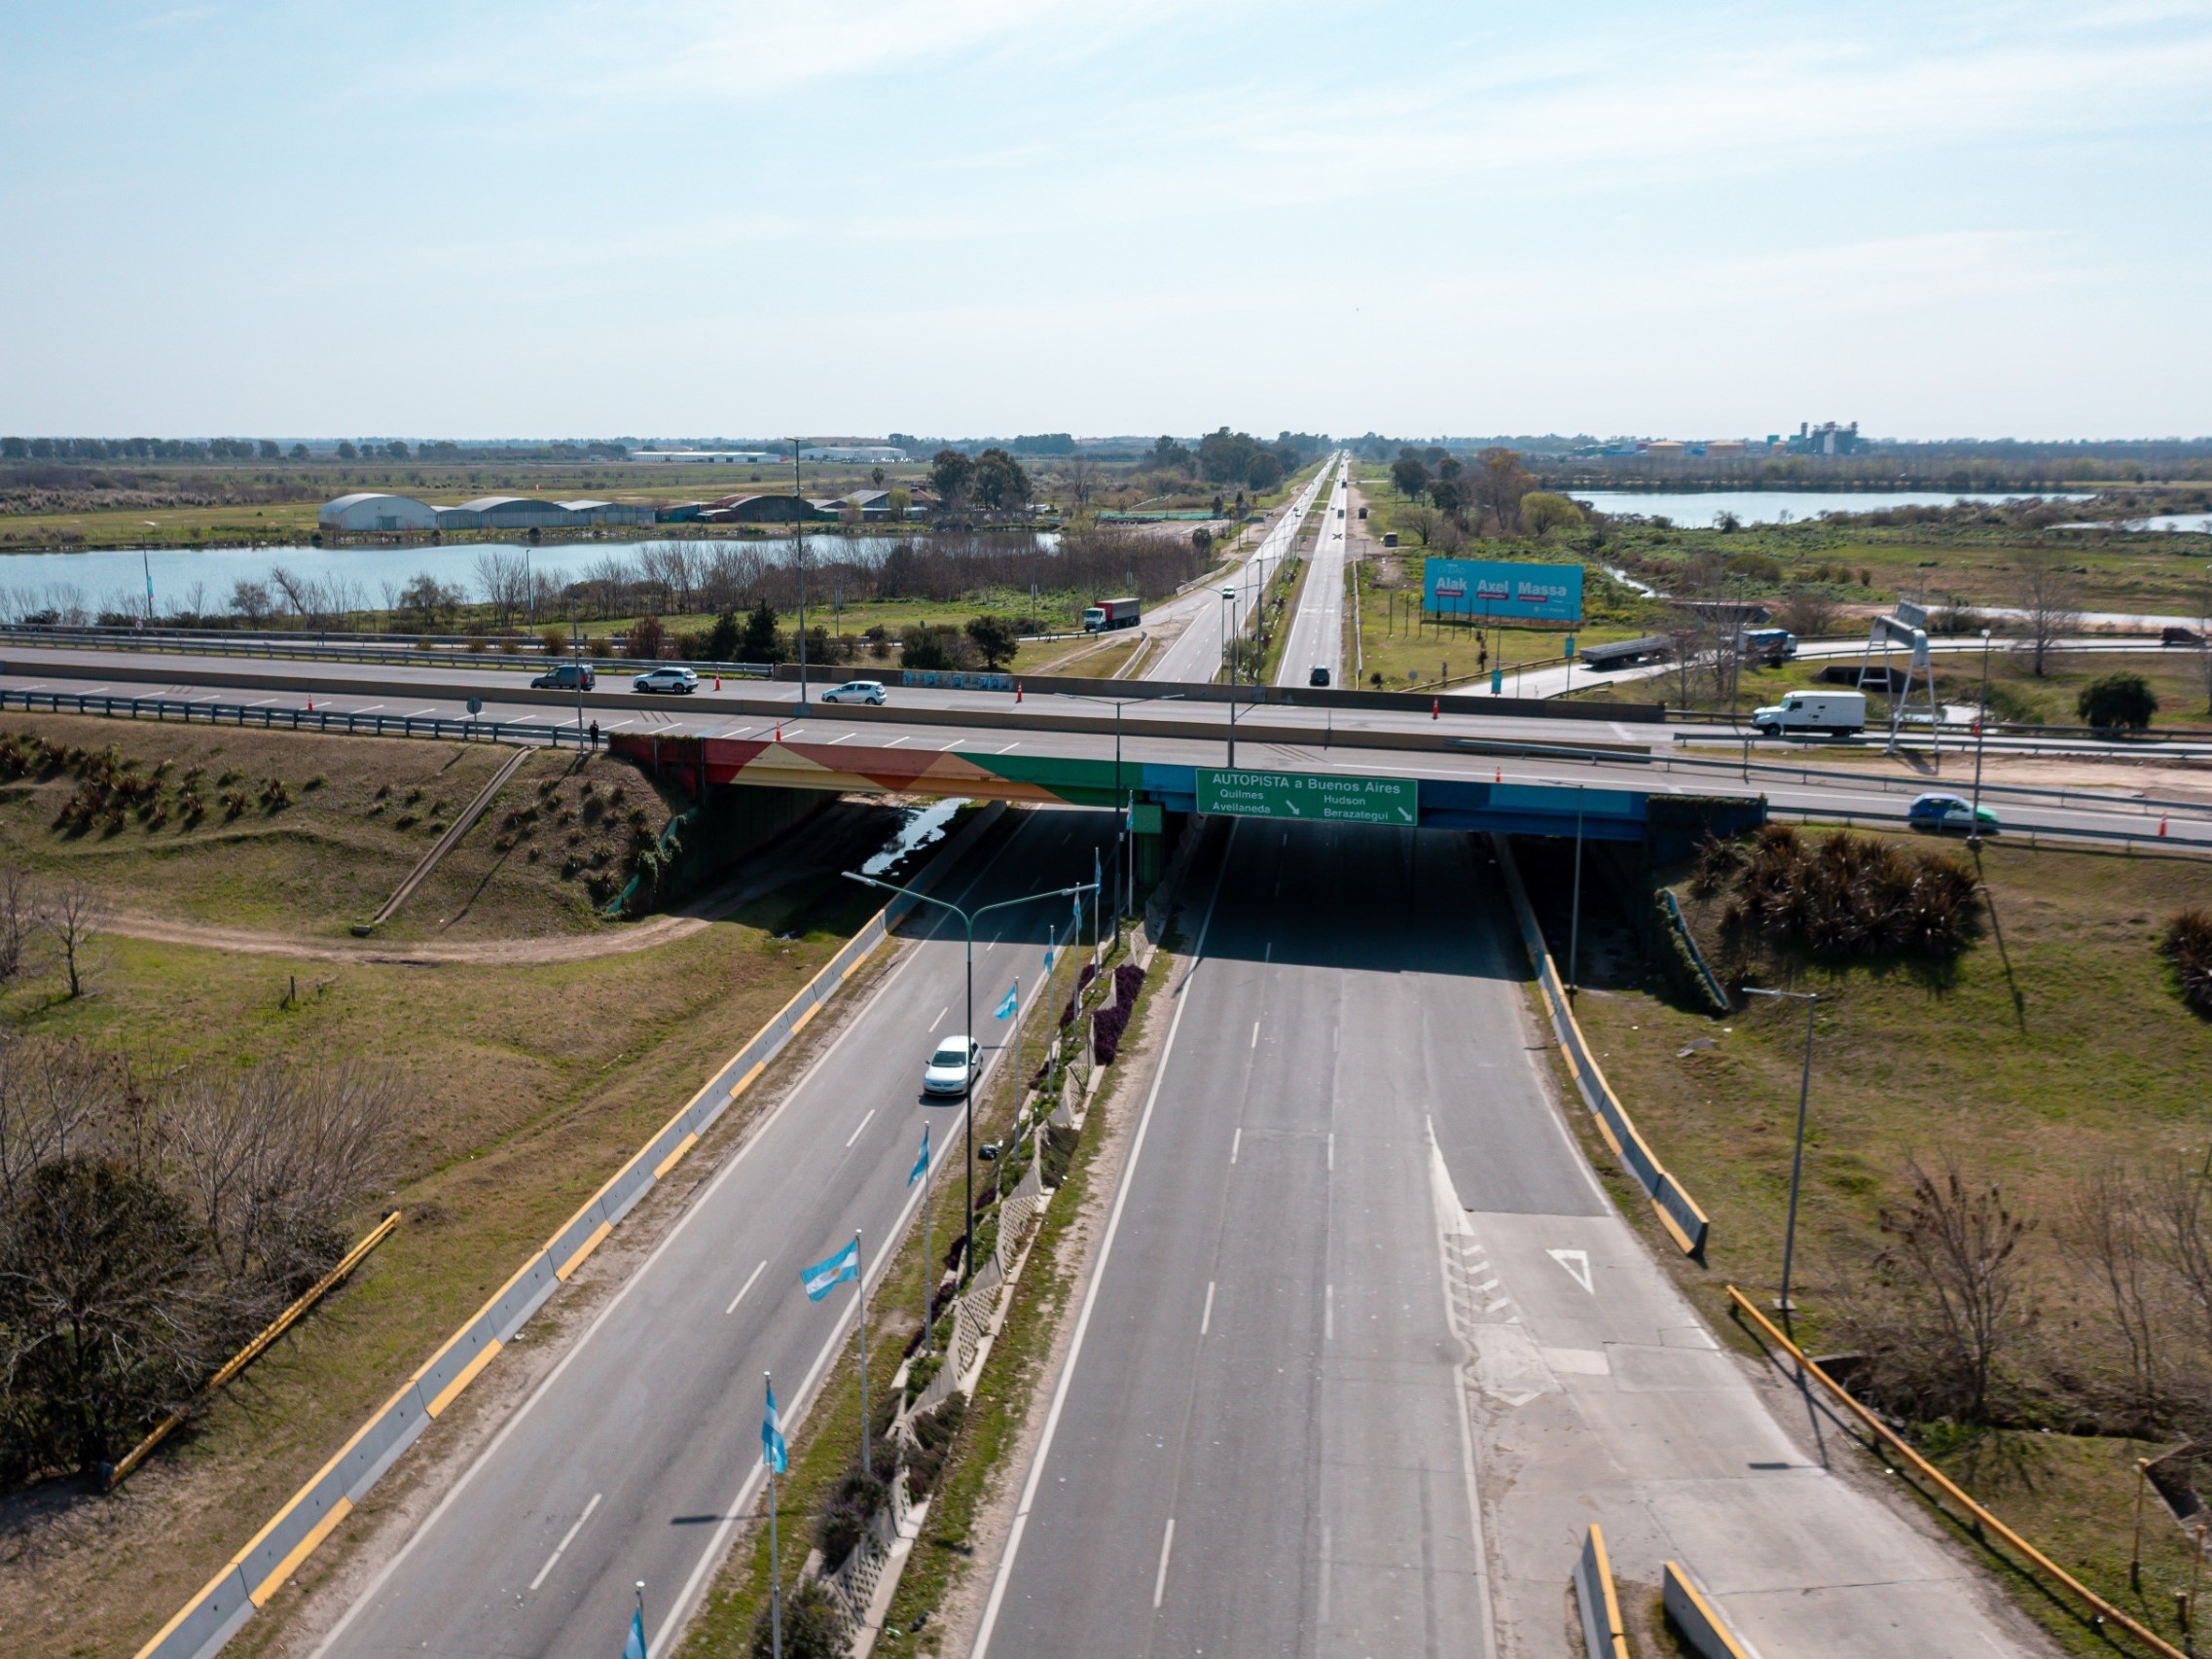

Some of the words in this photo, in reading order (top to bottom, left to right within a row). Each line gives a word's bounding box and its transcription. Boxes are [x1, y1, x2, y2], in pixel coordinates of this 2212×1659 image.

[1436, 577, 1468, 591] Alak
[1477, 579, 1508, 593] Axel
[1518, 582, 1567, 595] Massa
[1213, 774, 1289, 788] AUTOPISTA
[1294, 779, 1303, 789] a
[1308, 778, 1360, 792] Buenos
[1364, 781, 1401, 794] Aires
[1219, 788, 1264, 800] Quilmes
[1324, 795, 1366, 806] Hudson
[1212, 802, 1271, 813] Avellaneda
[1324, 808, 1389, 822] Berazategui
